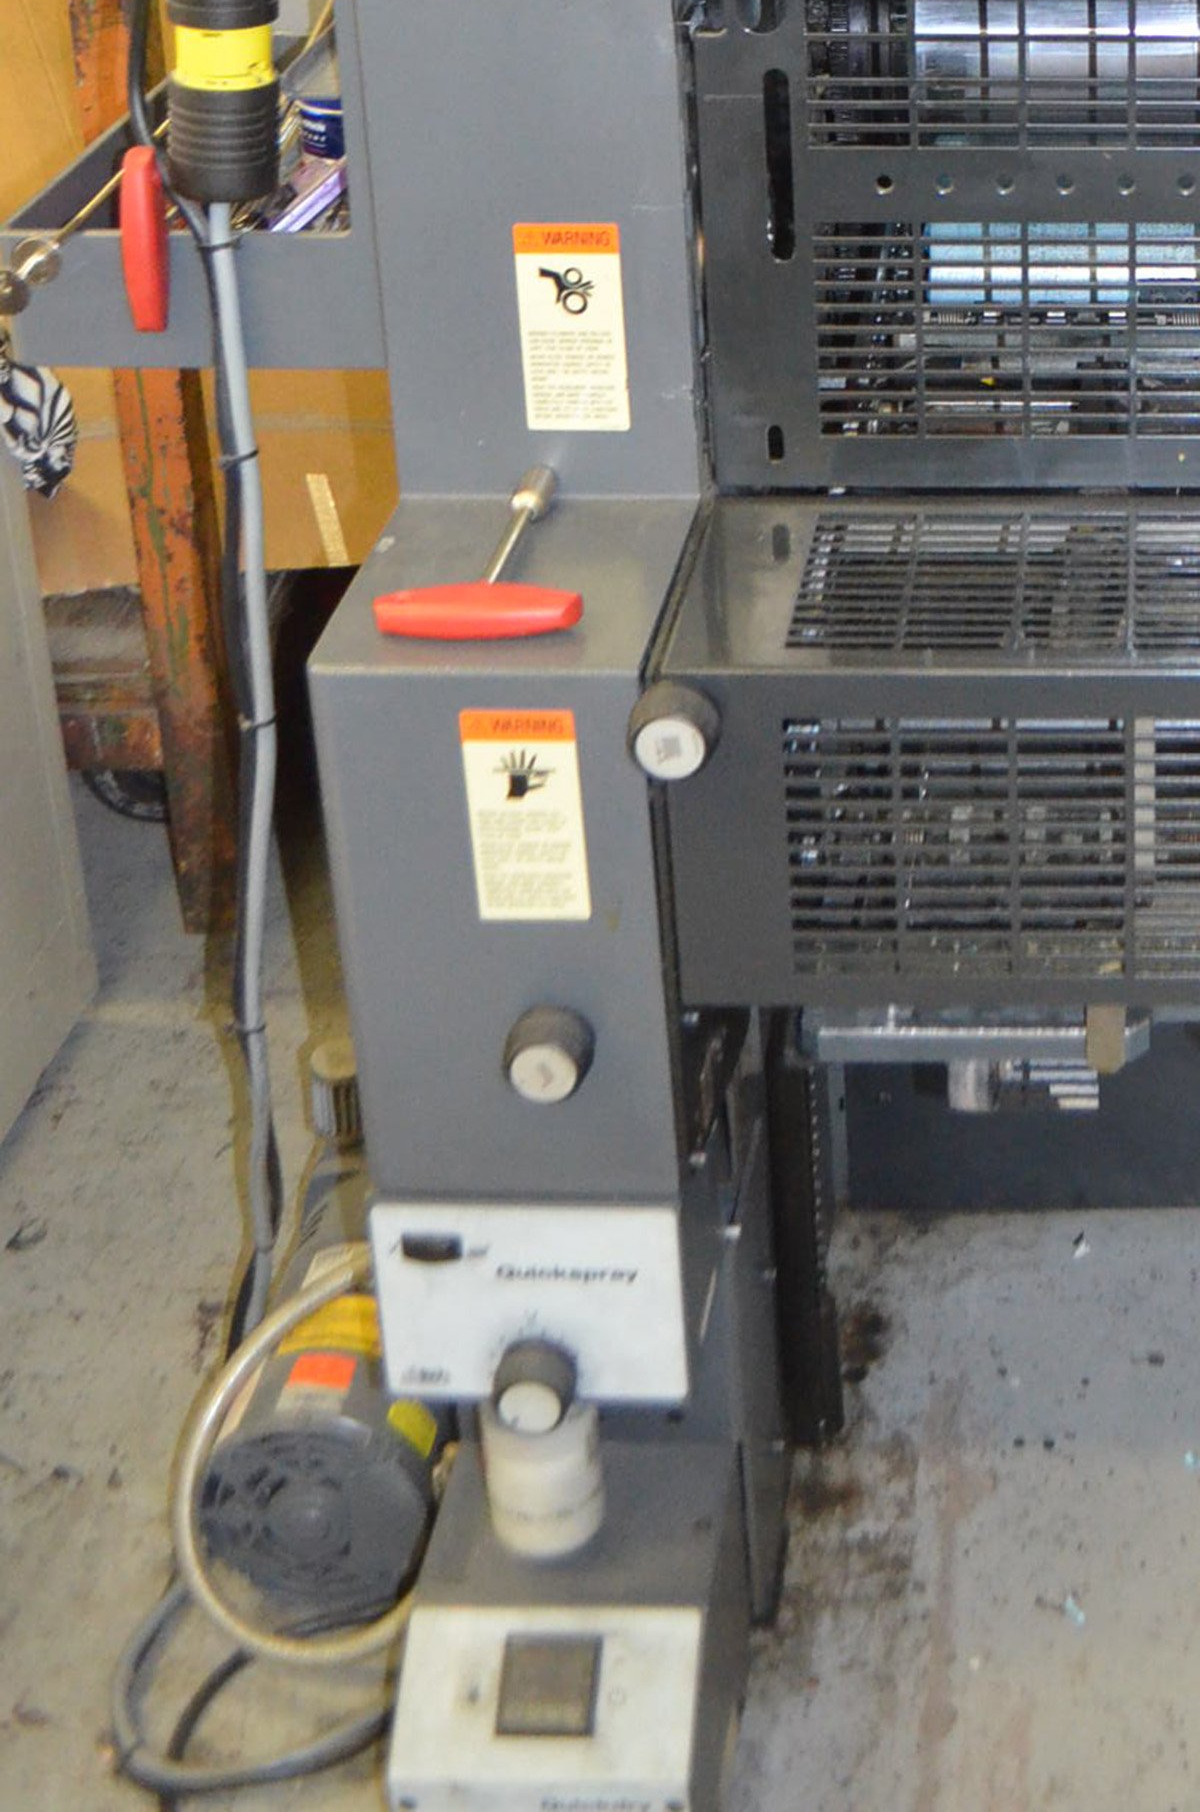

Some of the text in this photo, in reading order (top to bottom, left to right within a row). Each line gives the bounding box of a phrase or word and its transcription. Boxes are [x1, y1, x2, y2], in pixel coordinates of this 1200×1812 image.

[542, 230, 611, 248] WARNING
[489, 717, 565, 735] WARNING
[496, 1262, 639, 1286] Quickspray
